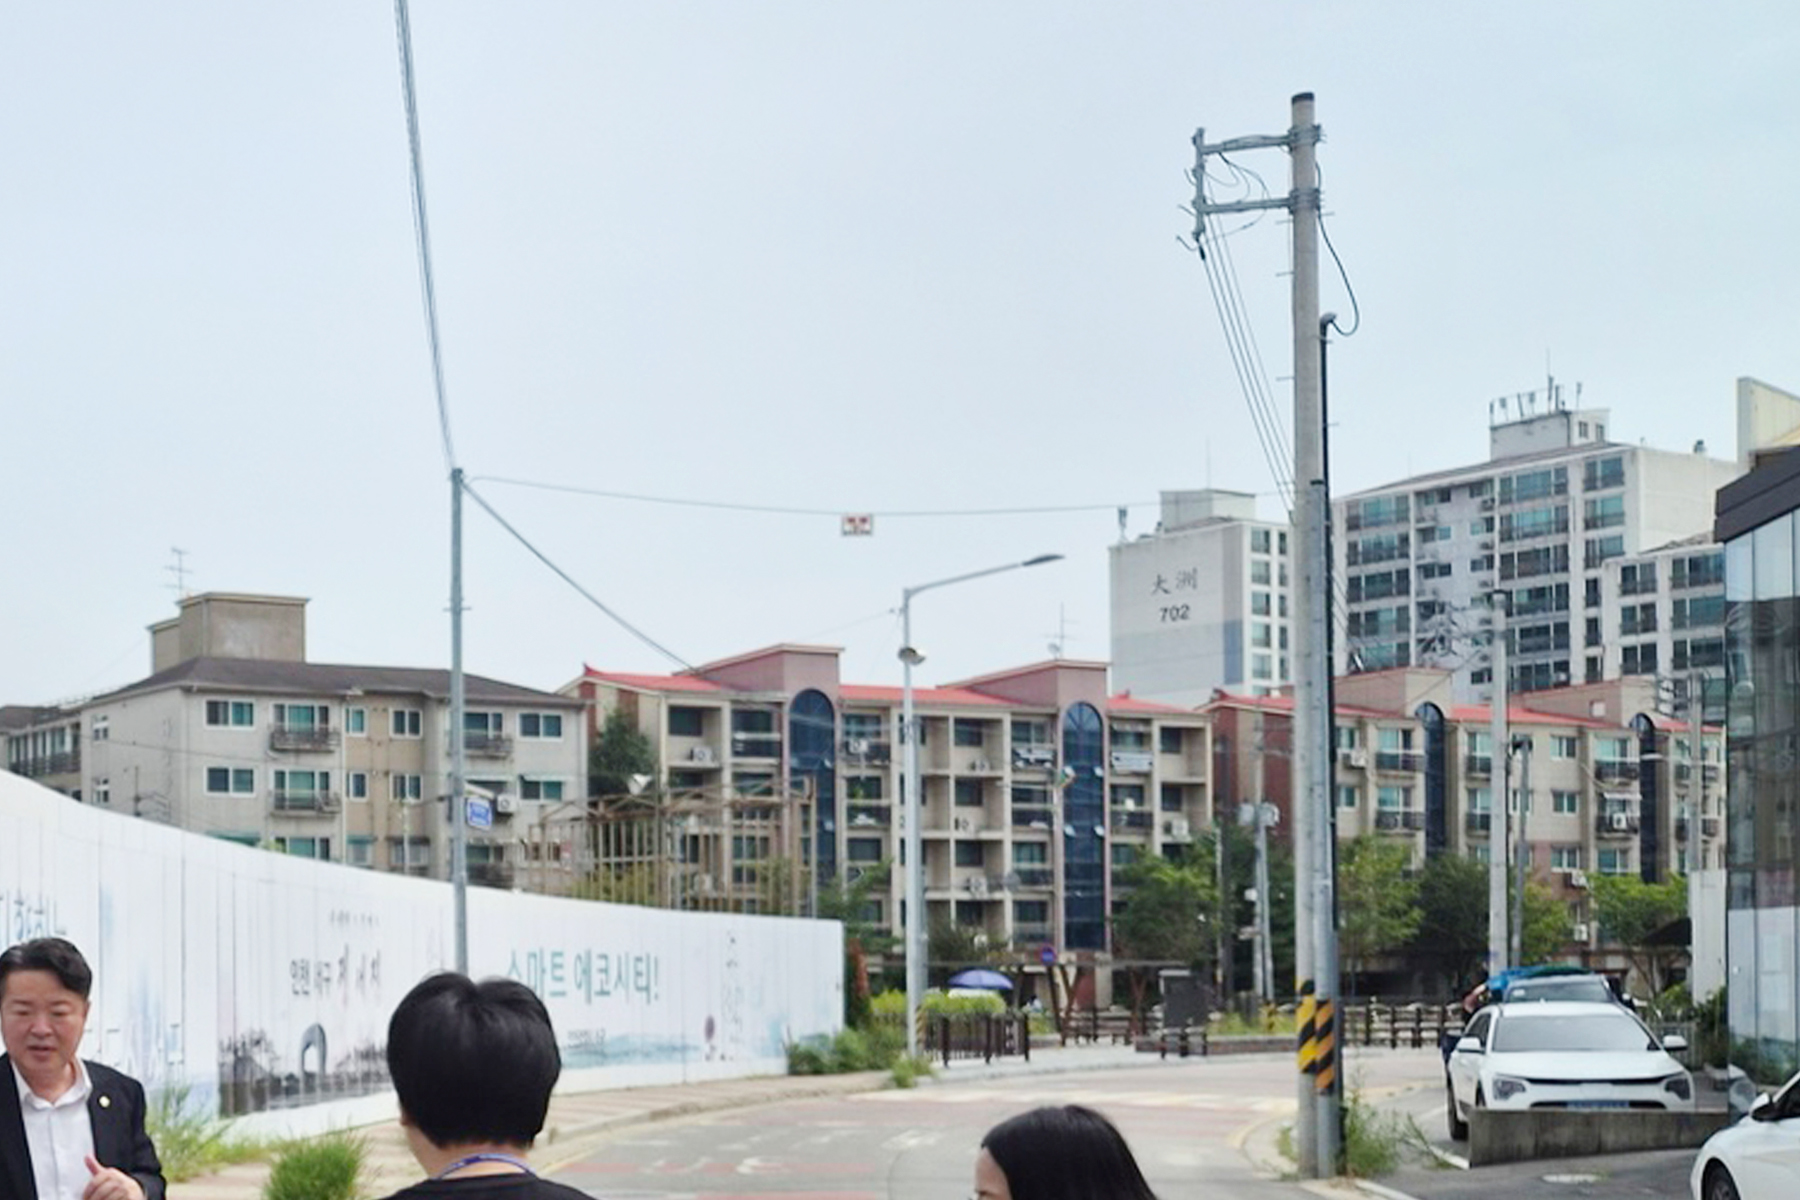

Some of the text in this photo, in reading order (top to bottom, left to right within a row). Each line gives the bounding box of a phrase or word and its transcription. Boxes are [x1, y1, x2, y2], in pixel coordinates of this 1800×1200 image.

[1159, 603, 1190, 623] 702
[507, 947, 568, 1001] 스마트
[573, 948, 660, 1006] 에코시티!
